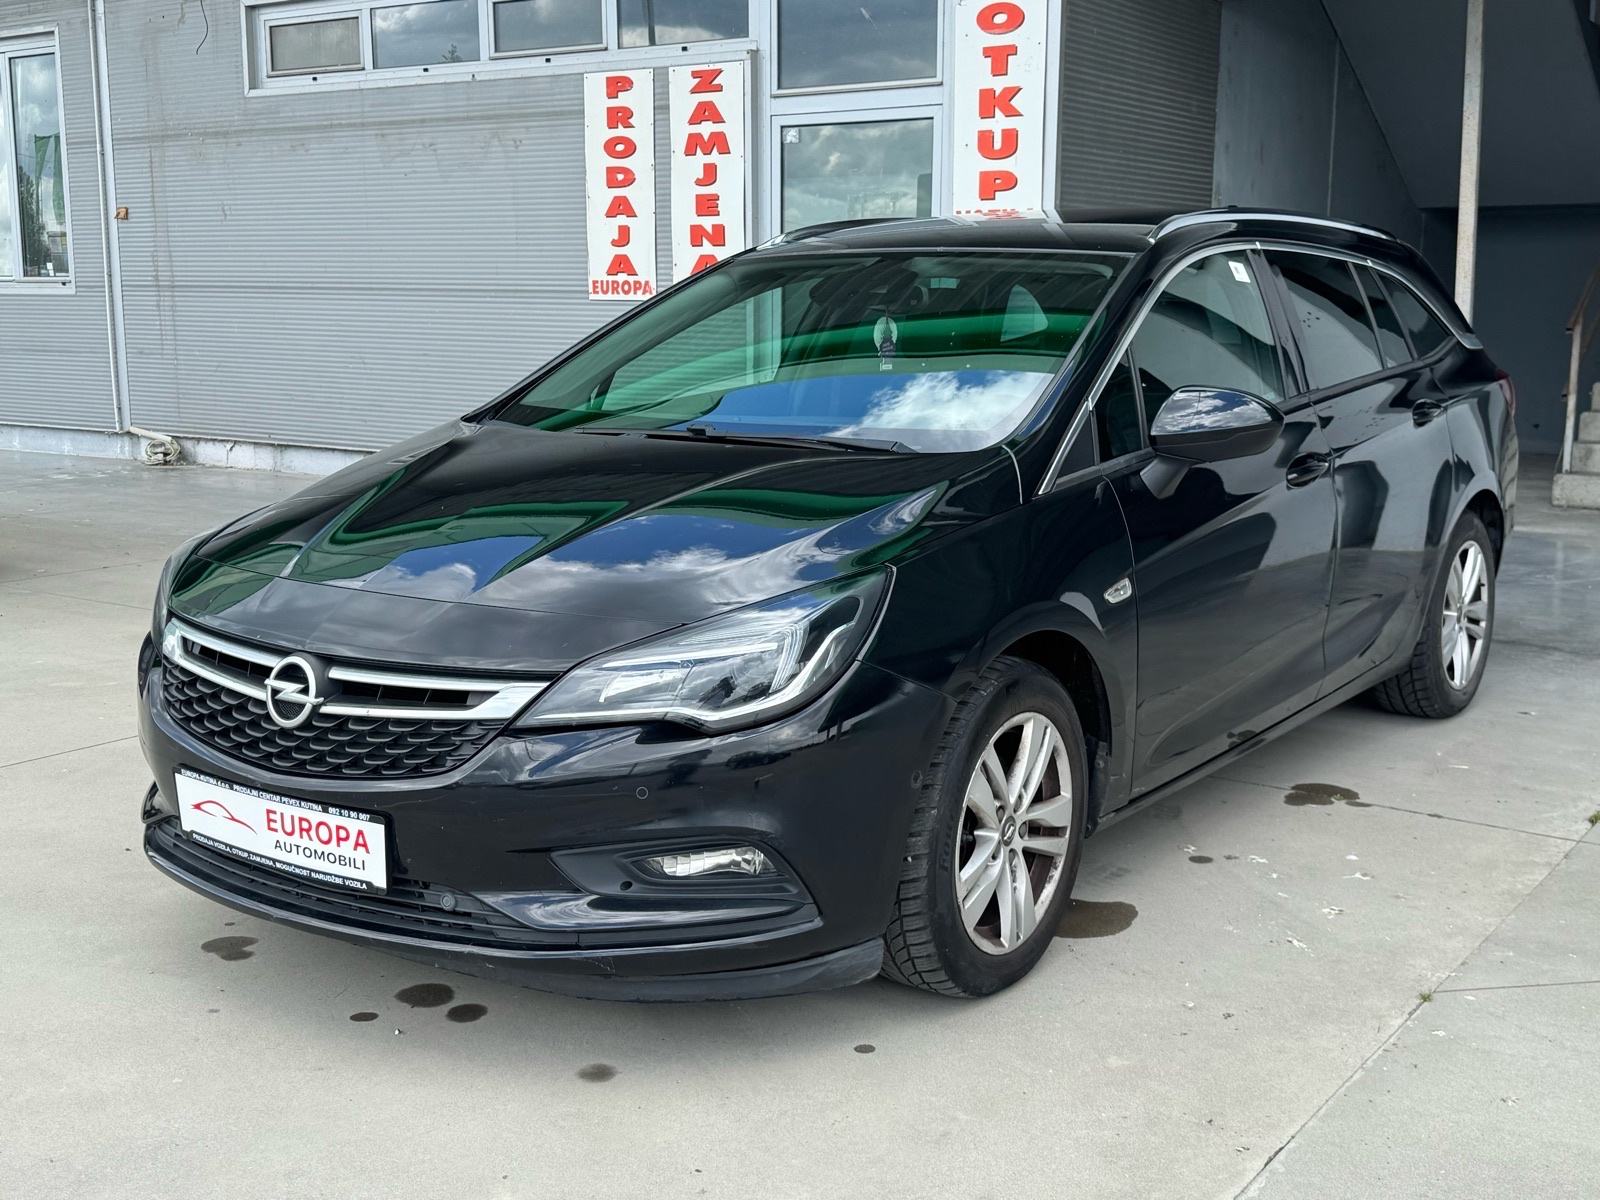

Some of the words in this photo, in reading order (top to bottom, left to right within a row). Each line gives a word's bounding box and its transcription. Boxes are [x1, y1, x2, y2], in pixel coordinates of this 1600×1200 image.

[976, 2, 1025, 201] OTKUP
[603, 75, 638, 277] PRODAJA
[684, 68, 731, 276] ZAMJENA
[591, 279, 653, 295] EUROPA
[233, 785, 258, 797] PRODAJNI
[259, 790, 280, 802] CENTAR
[281, 796, 300, 806] PEVEX
[300, 801, 322, 812] KUTINA
[328, 806, 339, 816] 092
[341, 809, 348, 817] 10
[350, 811, 358, 819] 90
[358, 812, 370, 822] 007
[265, 808, 370, 854] EUROPA
[274, 839, 365, 871] AUTOMOBILI
[311, 869, 344, 885] NARUDŽBE
[344, 879, 367, 890] VOZILA
